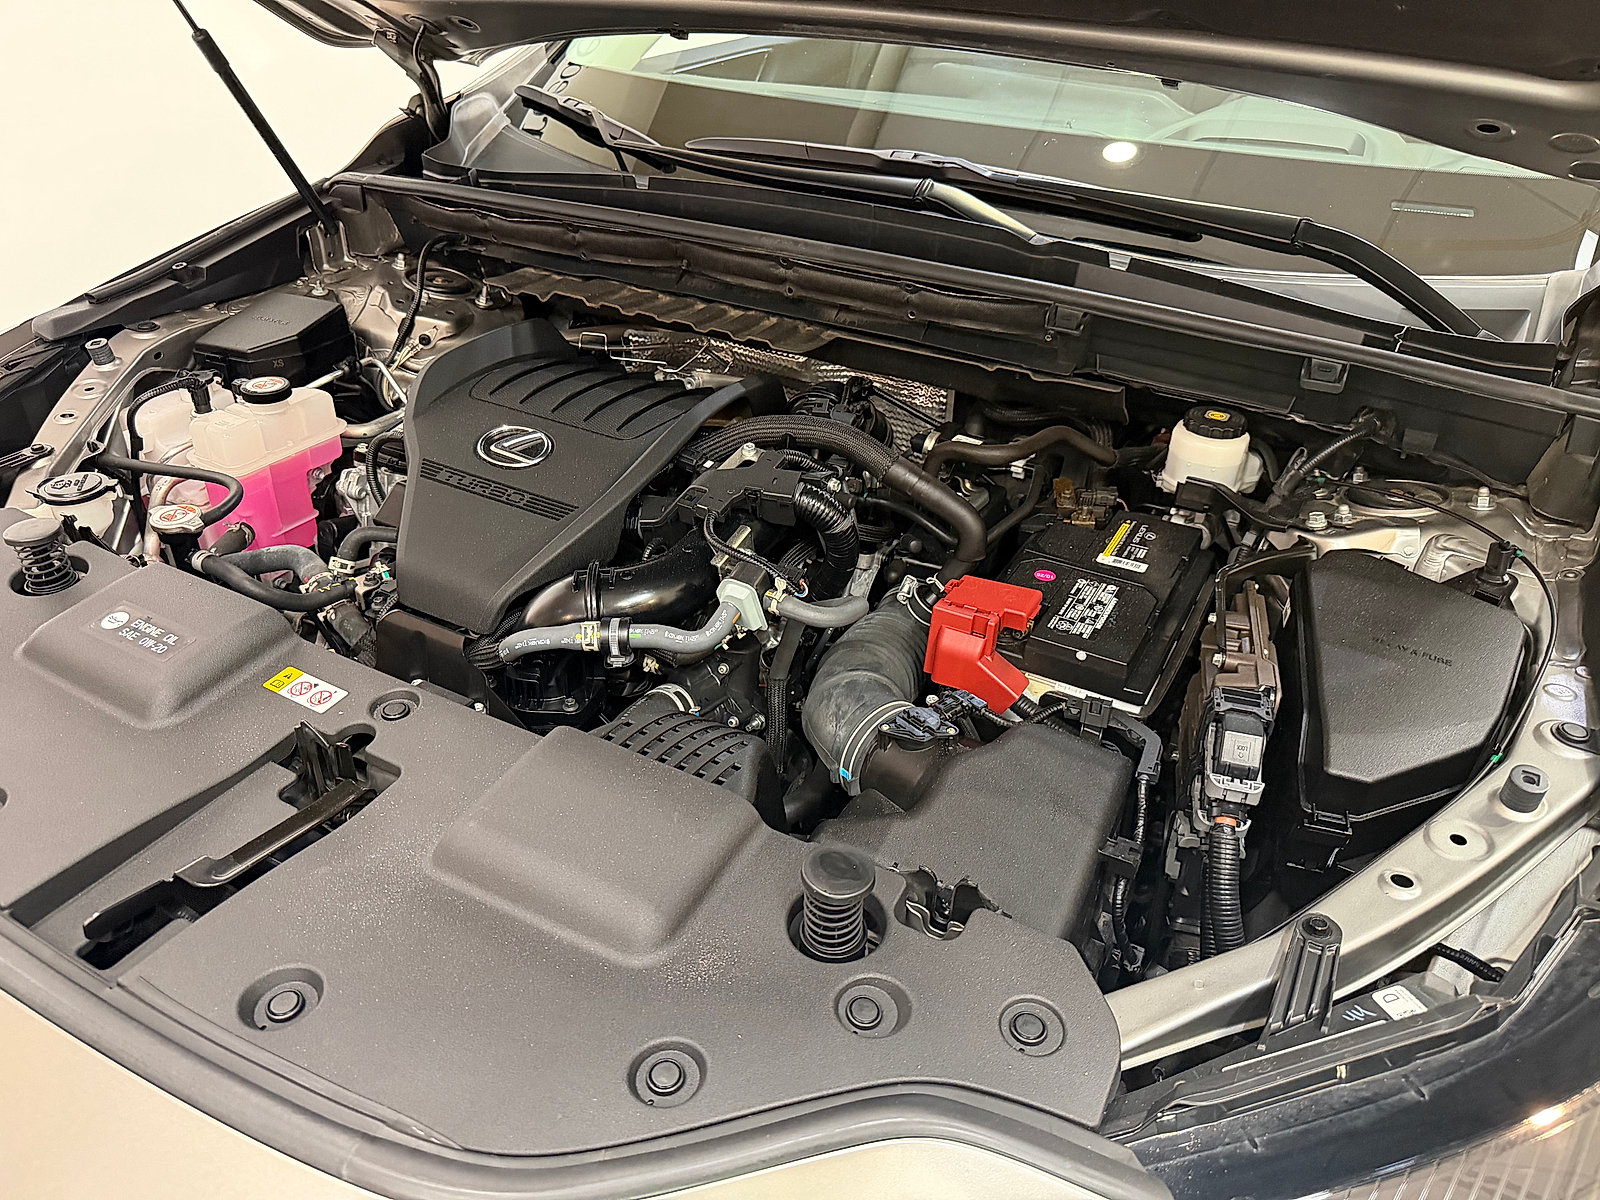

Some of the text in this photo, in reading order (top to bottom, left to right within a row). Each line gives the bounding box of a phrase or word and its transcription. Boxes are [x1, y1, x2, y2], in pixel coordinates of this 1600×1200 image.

[272, 359, 285, 368] XS
[438, 469, 527, 505] TURBO
[1132, 525, 1149, 543] LEXUS
[118, 627, 142, 641] SAE
[130, 618, 180, 646] ENGINE OIL
[1421, 651, 1452, 667] FUSE
